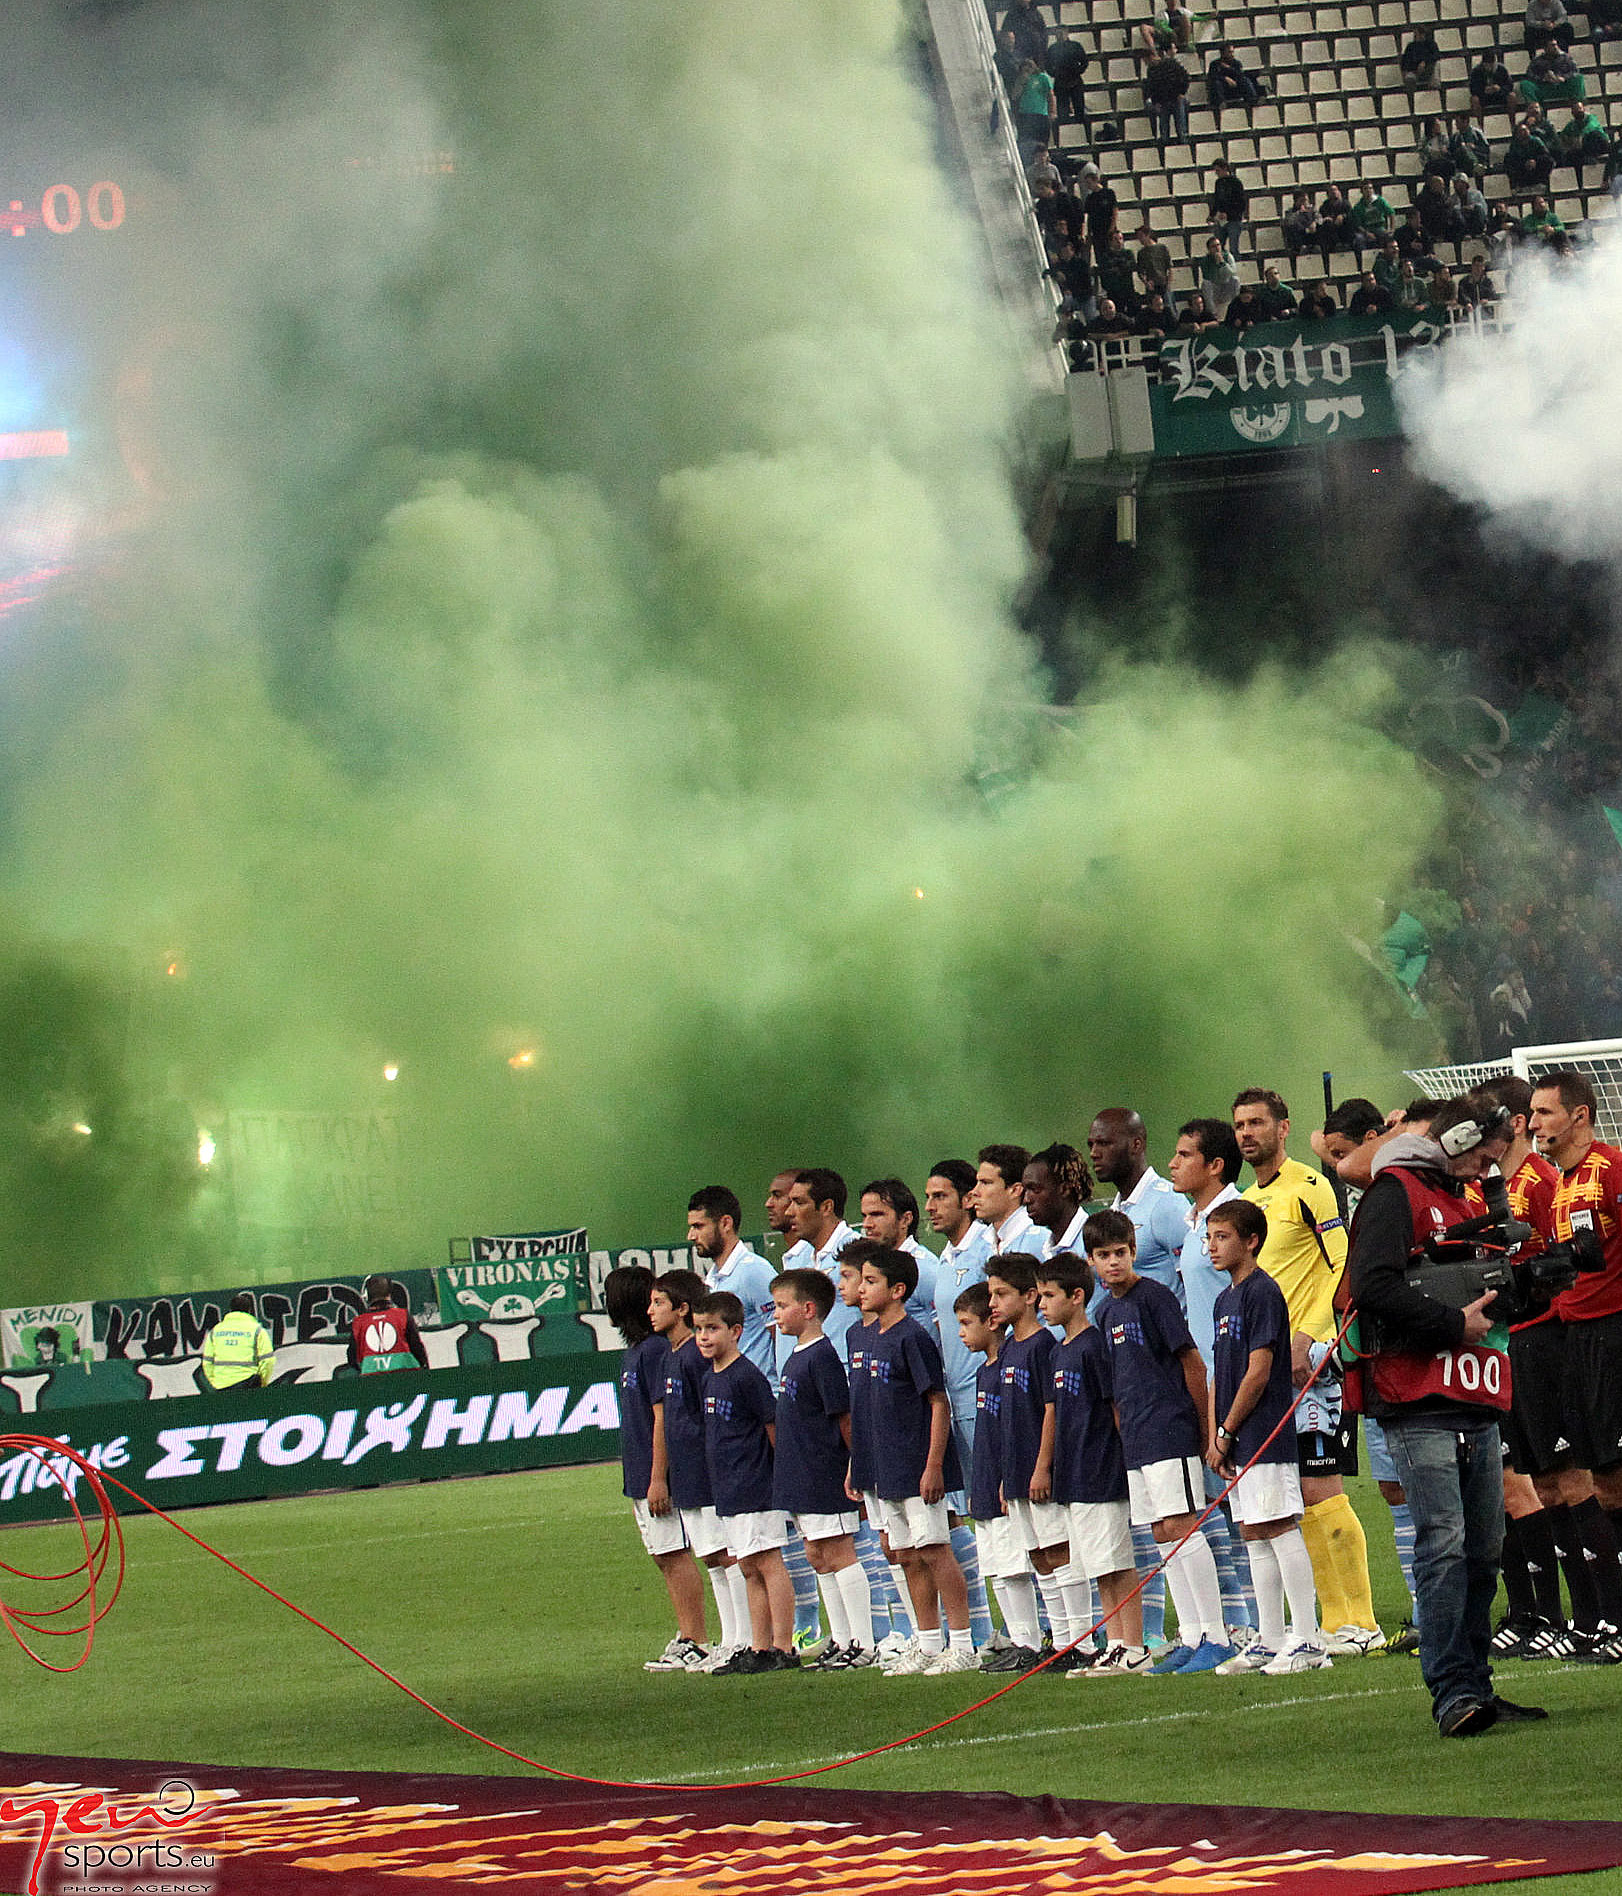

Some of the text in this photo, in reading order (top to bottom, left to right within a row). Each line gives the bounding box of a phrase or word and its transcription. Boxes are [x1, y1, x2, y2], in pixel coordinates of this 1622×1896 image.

[1161, 331, 1353, 402] Kiato
[446, 1258, 571, 1288] VIRONAS
[9, 1305, 85, 1330] MENIDI
[373, 1355, 392, 1370] TV
[1436, 1349, 1501, 1395] 100
[1306, 1456, 1336, 1467] macron
